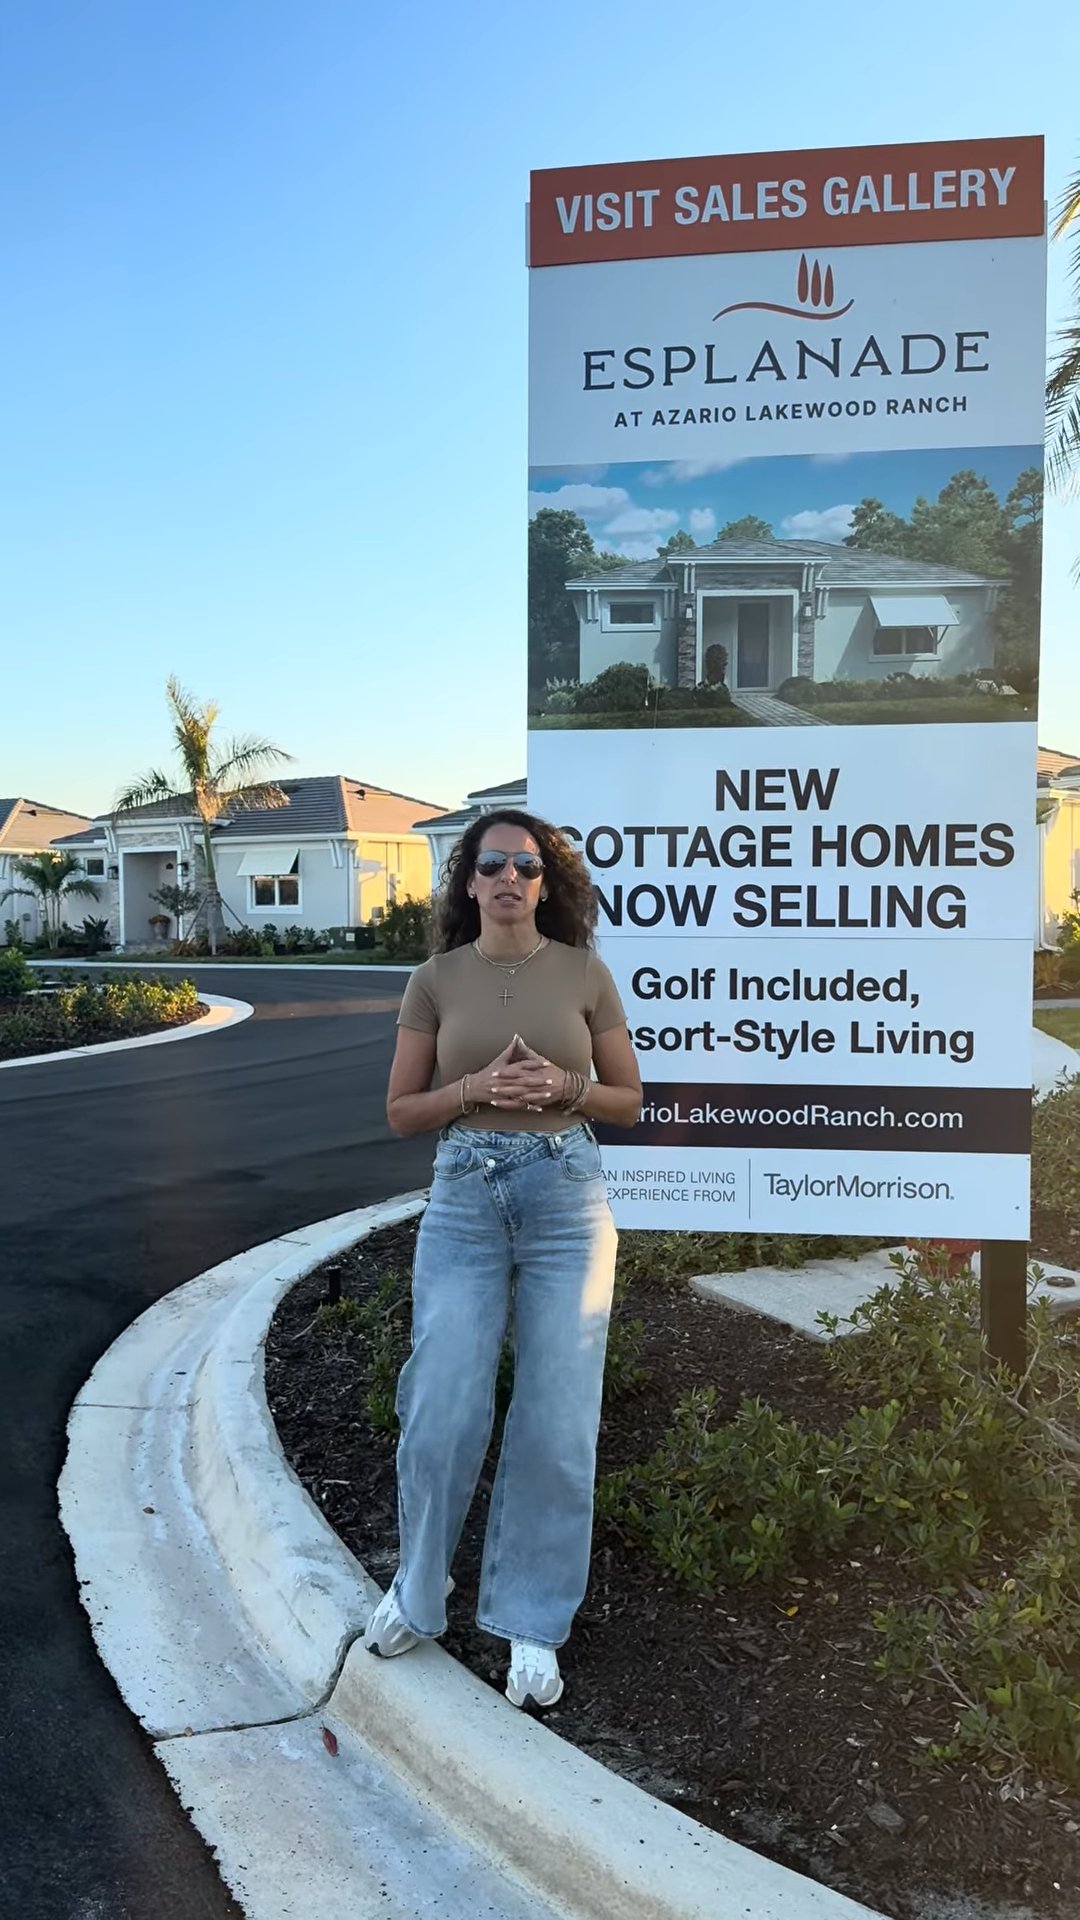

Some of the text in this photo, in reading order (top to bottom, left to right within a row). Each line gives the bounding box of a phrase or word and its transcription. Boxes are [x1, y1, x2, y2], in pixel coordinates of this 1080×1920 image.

[556, 166, 1017, 234] VISIT SALES GALLERY
[582, 331, 990, 391] ESPLANADE
[614, 395, 968, 428] AT AZARIO LAKEWOOD RANCH
[715, 767, 841, 812] NEW
[811, 822, 1015, 868] HOMES
[592, 883, 967, 930] NOW SELLING
[631, 966, 920, 1009] Golf Included,
[627, 1018, 975, 1064] sort-Style Living
[637, 1102, 963, 1129] rioLakewoodRanch.com
[600, 1169, 736, 1185] AN INSPIRED LIVING
[606, 1187, 736, 1203] EXPERIENCE FROM
